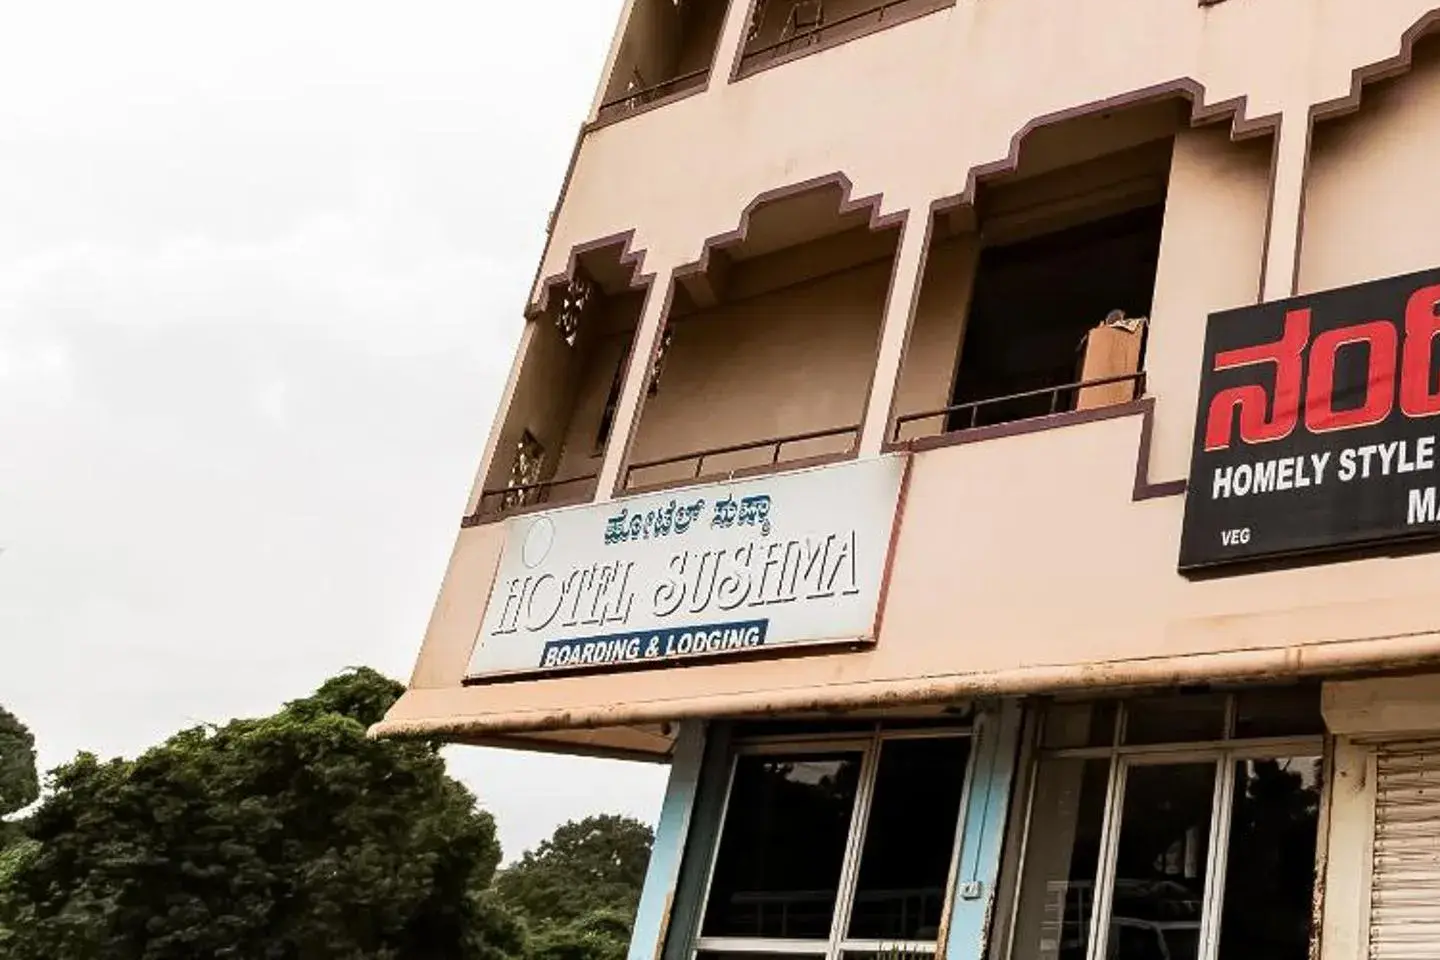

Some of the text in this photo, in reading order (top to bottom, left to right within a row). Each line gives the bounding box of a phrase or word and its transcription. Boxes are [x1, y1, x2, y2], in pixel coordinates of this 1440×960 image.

[1212, 451, 1331, 499] HOMELY
[1337, 435, 1436, 480] STYLE
[1221, 527, 1251, 546] VEG
[491, 530, 860, 636] HOTEL SUSHMA
[546, 626, 761, 667] BOARDING & LODGING
